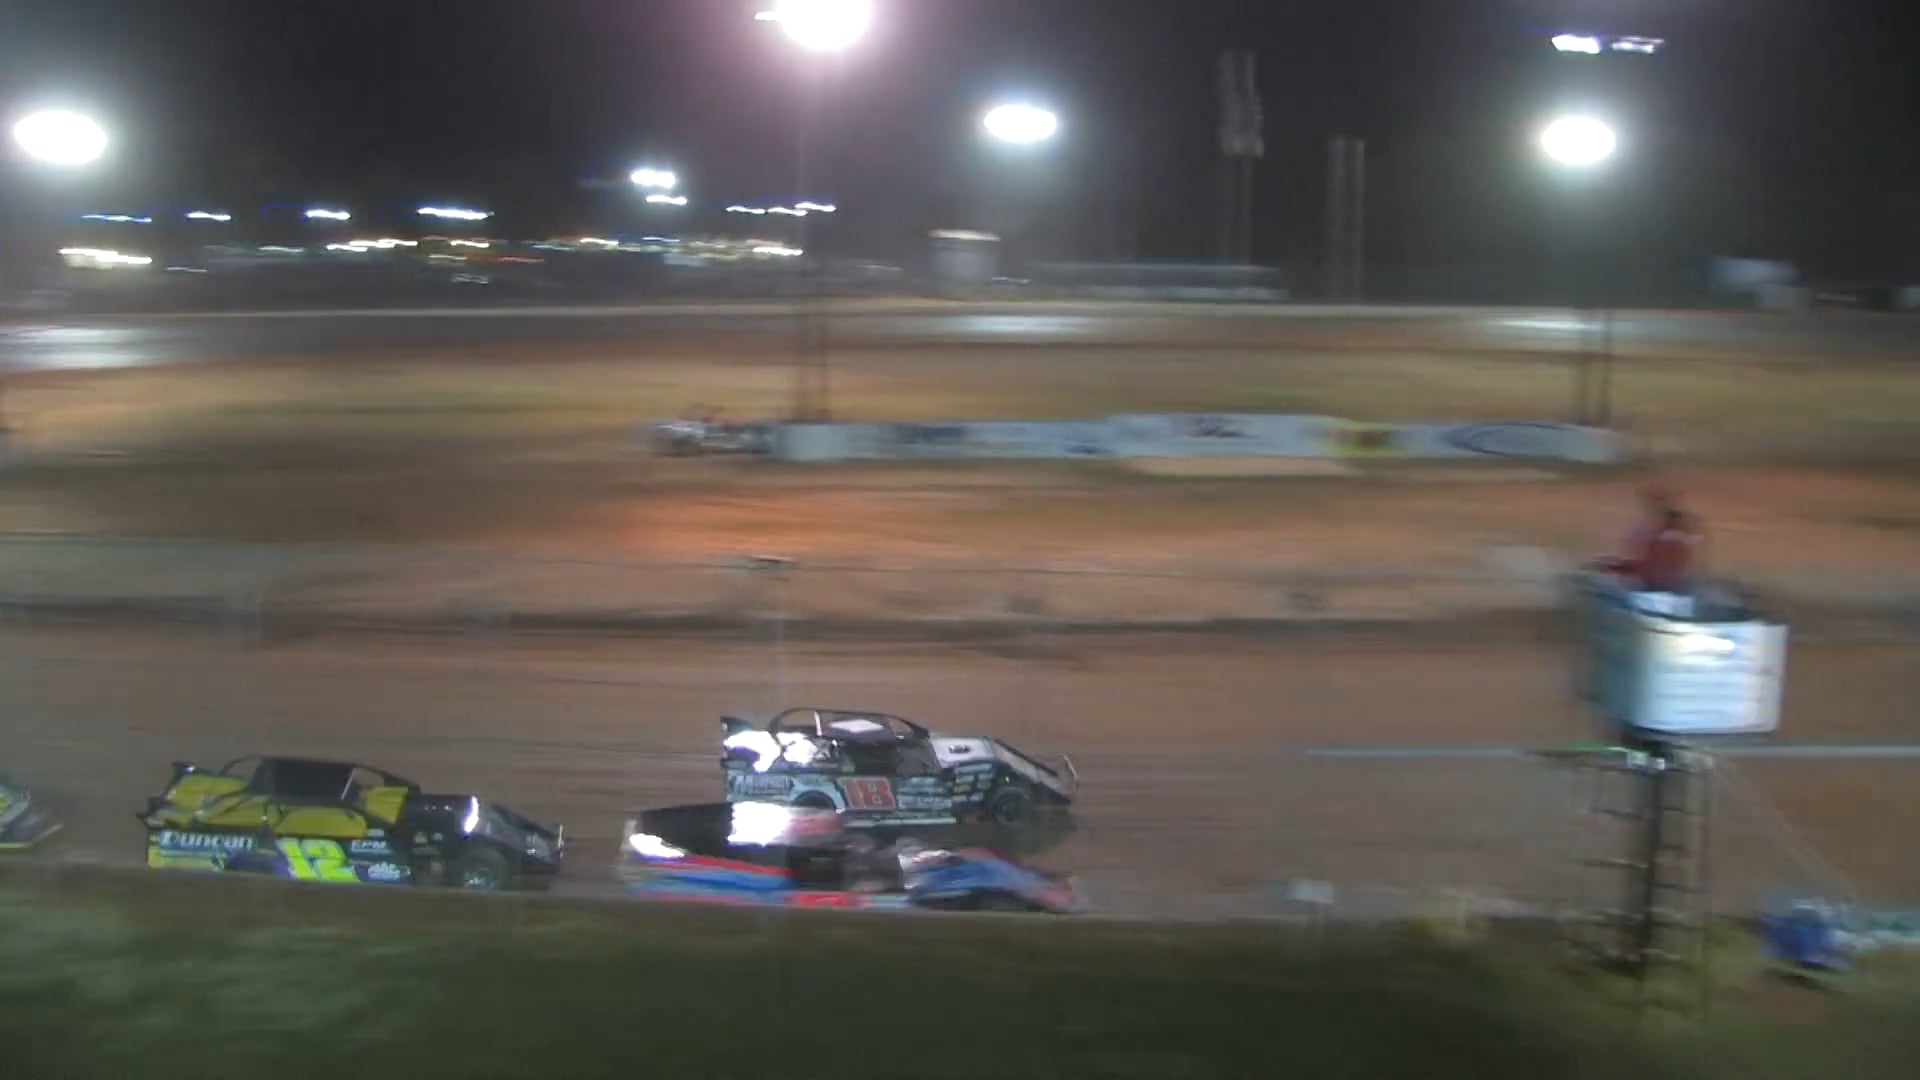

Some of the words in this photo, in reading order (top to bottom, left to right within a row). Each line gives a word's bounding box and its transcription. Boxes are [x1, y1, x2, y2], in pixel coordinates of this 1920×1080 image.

[842, 776, 896, 810] 18
[160, 831, 254, 849] Duncan
[277, 837, 360, 883] 12
